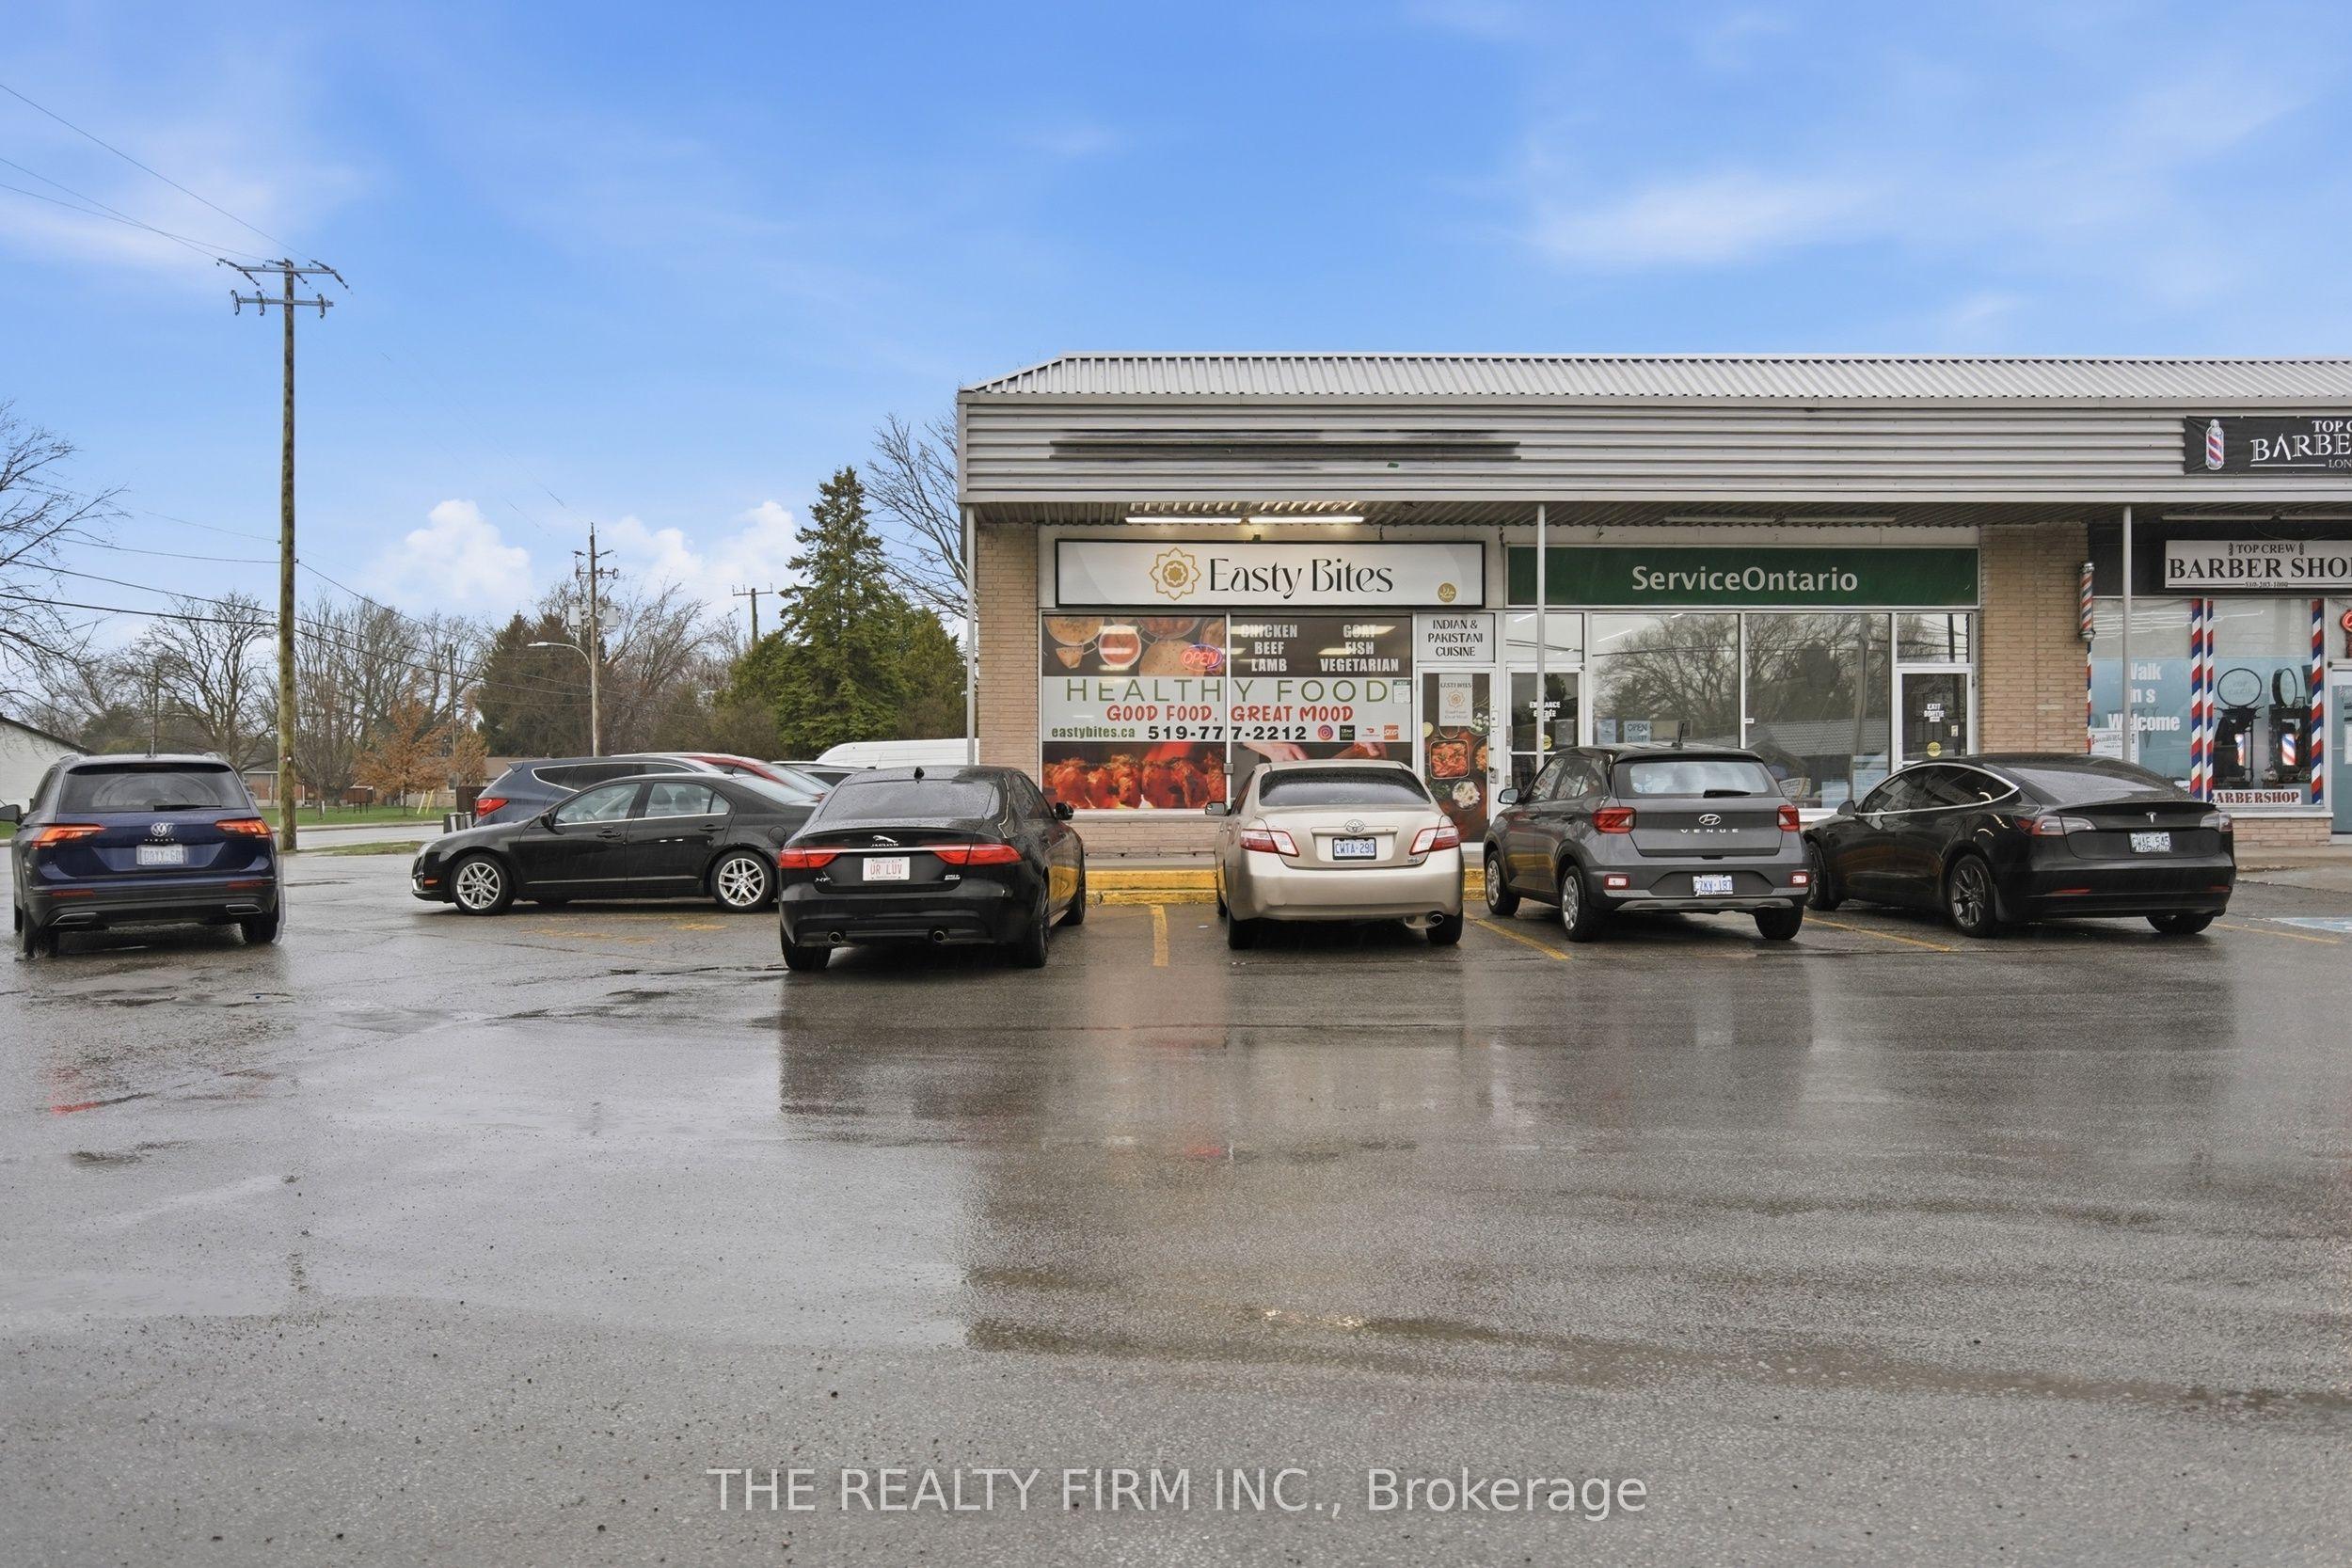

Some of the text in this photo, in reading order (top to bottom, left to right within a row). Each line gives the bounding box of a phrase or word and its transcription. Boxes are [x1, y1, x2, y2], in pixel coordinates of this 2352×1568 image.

[2312, 420, 2344, 433] TOP
[2236, 543, 2296, 554] TOP CREW
[2168, 557, 2352, 578] BARBER SHO
[1209, 558, 1394, 600] Easty Bites
[1631, 565, 1858, 592] ServiceOntario
[1240, 625, 1298, 638] CHICKEN
[1343, 625, 1376, 638] GOAT
[1432, 619, 1478, 630] INDIAN &
[1427, 632, 1484, 643] PAKISTANI
[1254, 641, 1285, 655] BEEF
[1344, 641, 1375, 655] FISH
[1435, 645, 1476, 657] CUISINE
[1183, 651, 1218, 665] OPEN
[1251, 658, 1288, 672] LAMB
[1320, 658, 1399, 672] VEGETARIAN
[1066, 678, 1388, 702] HEALTHY FOOD
[1106, 705, 1159, 721] GOOD
[1230, 705, 1293, 721] GREAT
[1299, 705, 1354, 721] MOOD
[1051, 725, 1307, 740] eastybites.ca 519-777-2212
[1627, 723, 1648, 732] OPEN
[2212, 790, 2300, 804] ARBERSHOP
[870, 866, 903, 876] UR LUV
